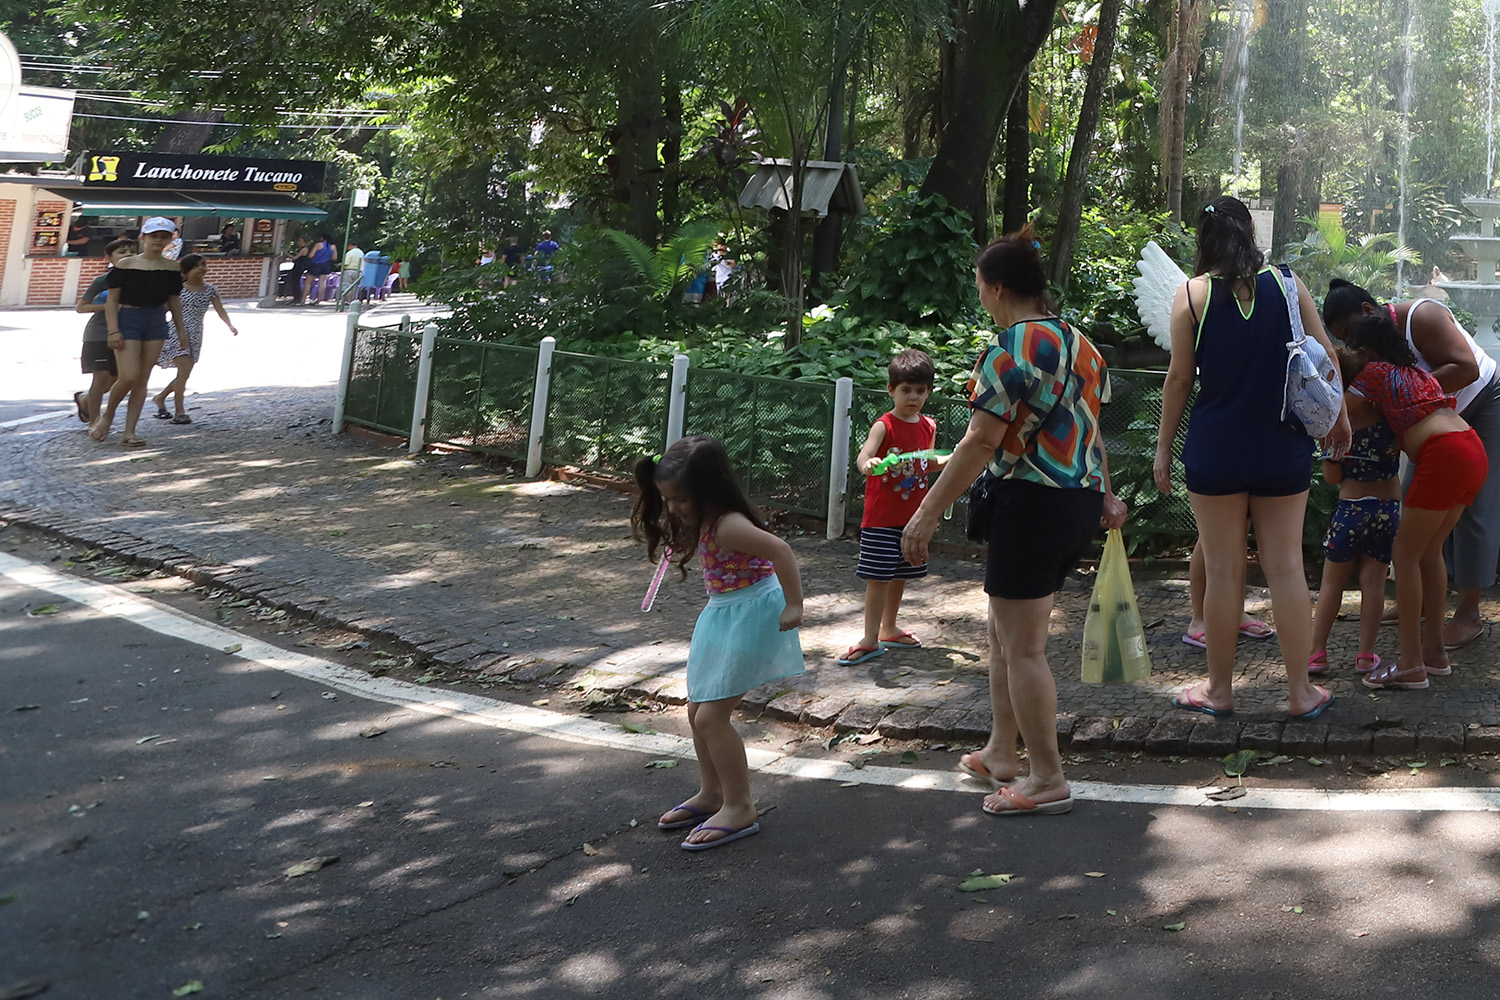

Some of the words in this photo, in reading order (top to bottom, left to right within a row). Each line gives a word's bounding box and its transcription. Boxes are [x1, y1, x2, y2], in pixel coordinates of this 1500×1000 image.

[24, 105, 43, 123] SUCOS
[132, 162, 240, 183] Lanchonete
[243, 166, 303, 184] Tucano
